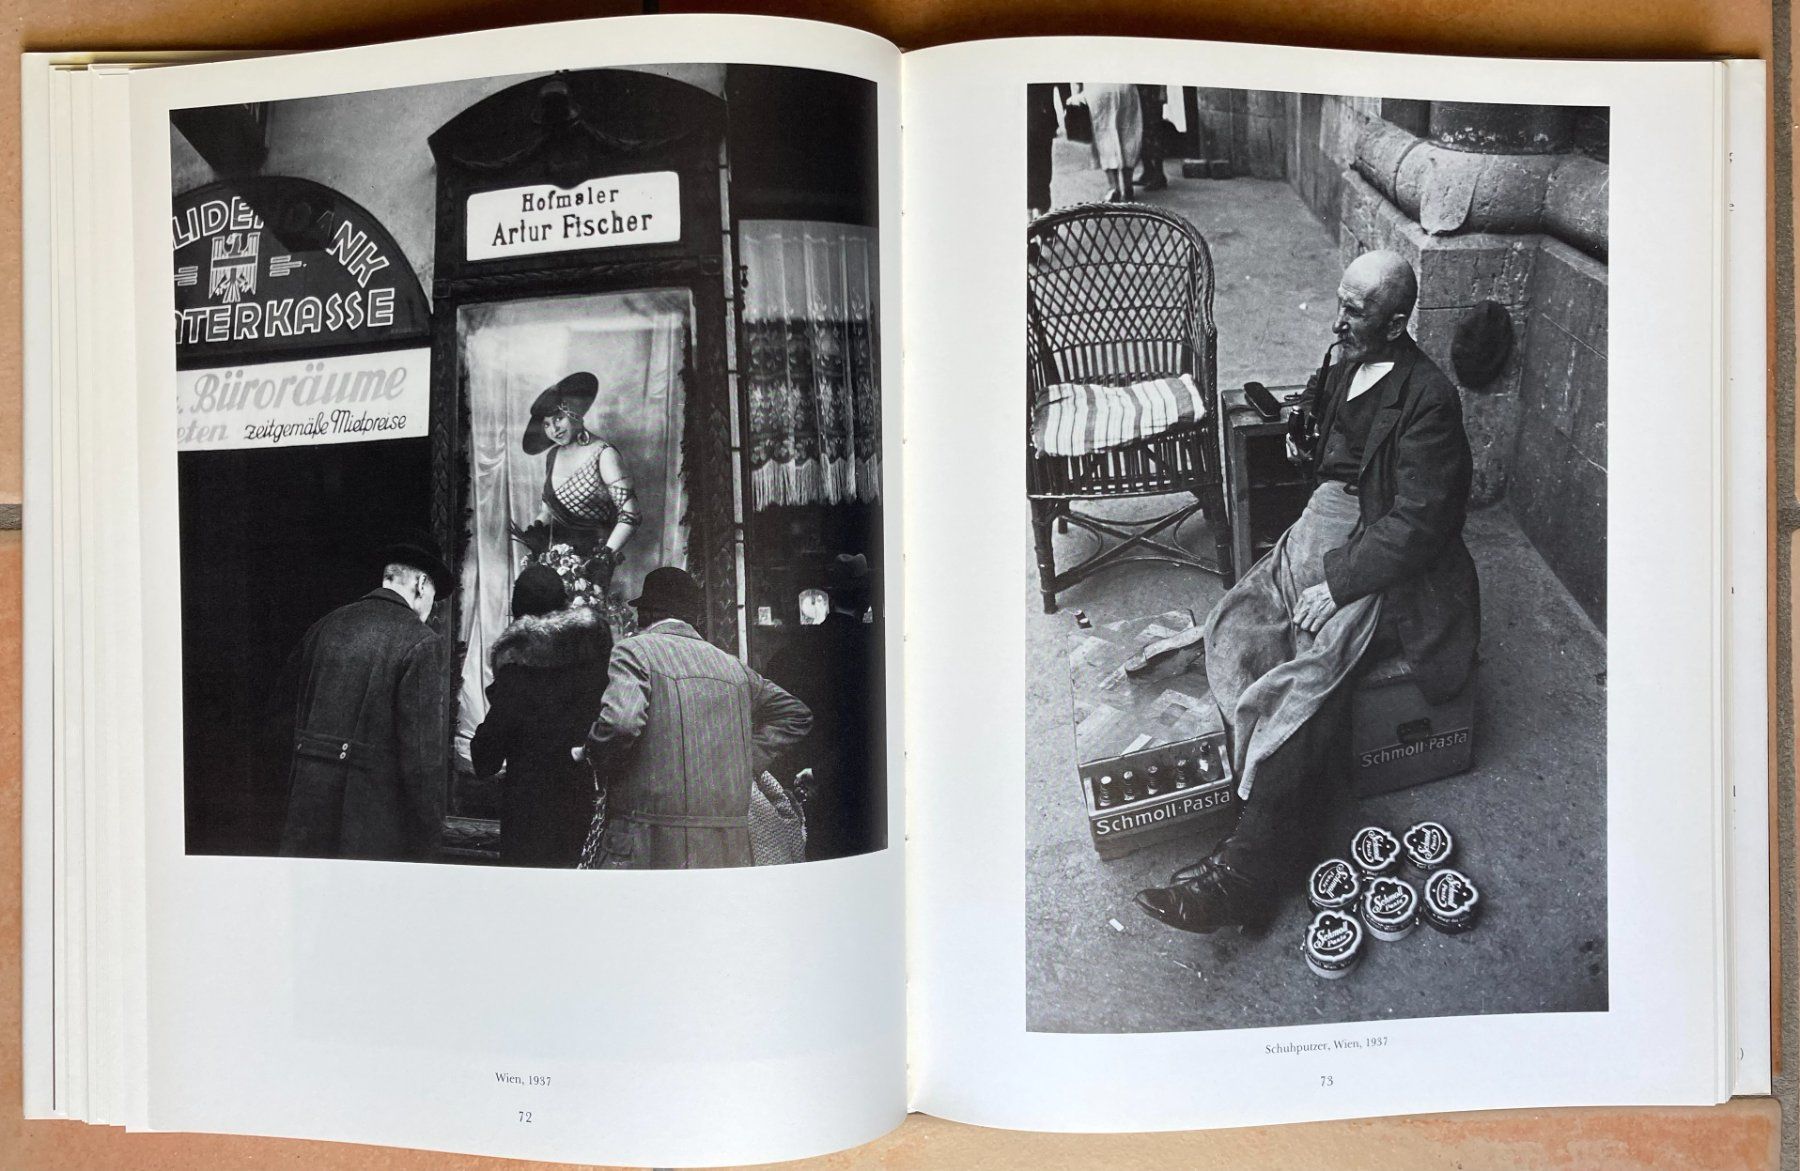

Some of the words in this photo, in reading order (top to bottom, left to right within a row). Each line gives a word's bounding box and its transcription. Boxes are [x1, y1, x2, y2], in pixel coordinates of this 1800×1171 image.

[522, 187, 619, 212] Hofmaler
[491, 219, 553, 246] Artur
[562, 211, 653, 238] Fischer
[189, 361, 407, 413] Büroräume
[243, 411, 329, 443] zeitgemäße
[330, 409, 407, 435] Mietpreise
[1265, 1042, 1331, 1055] Schuhputzer,
[1333, 1039, 1362, 1050] Wien,
[1366, 1036, 1388, 1047] 1937
[495, 1072, 525, 1085] Wien,
[529, 1075, 552, 1086] 1937
[1320, 1075, 1334, 1087] 73
[518, 1111, 532, 1123] 72
